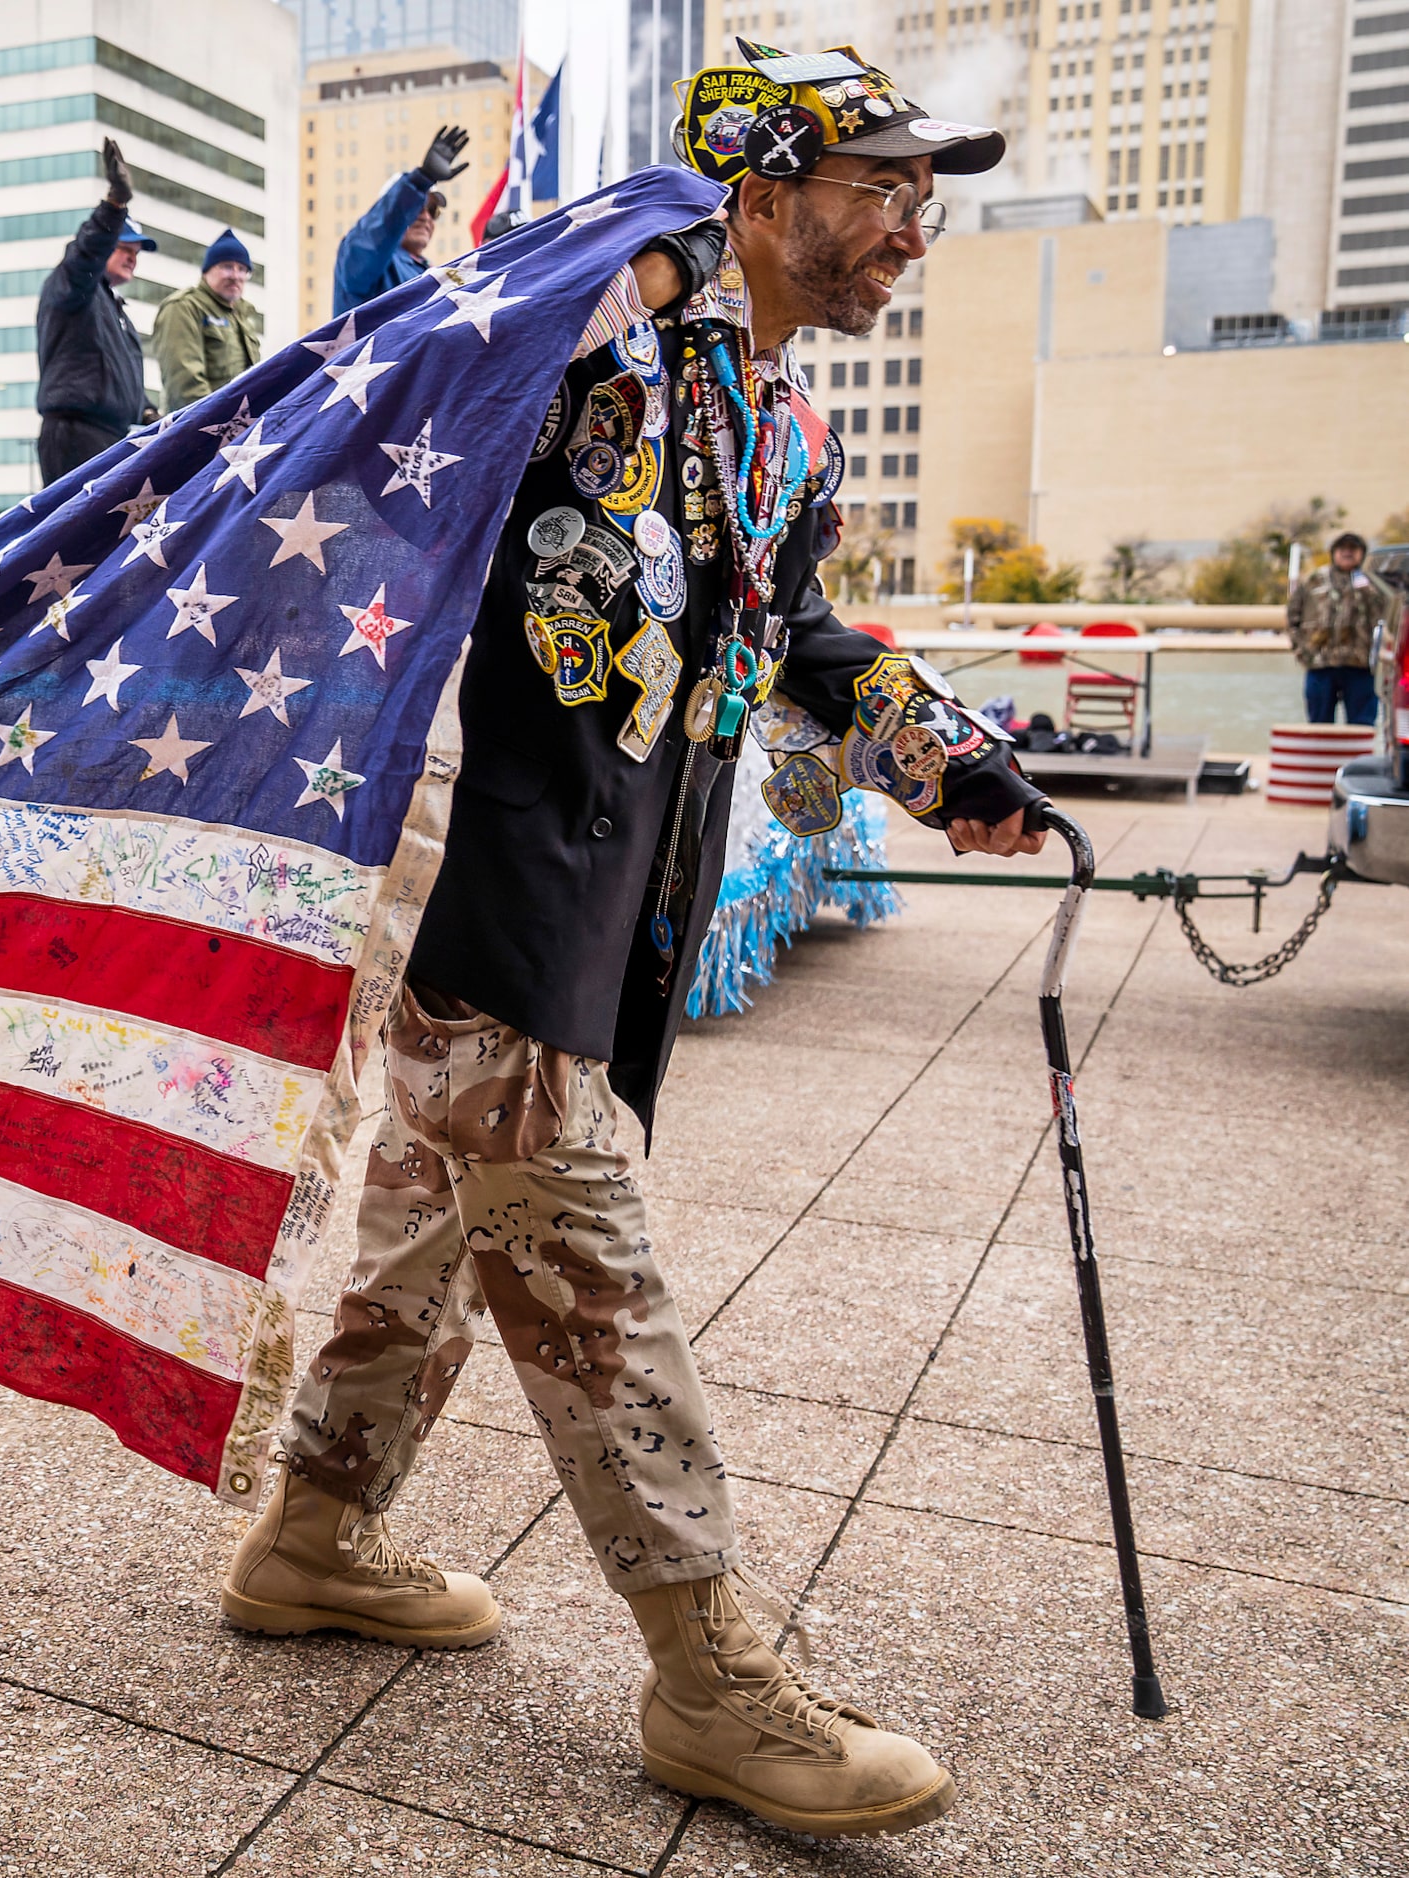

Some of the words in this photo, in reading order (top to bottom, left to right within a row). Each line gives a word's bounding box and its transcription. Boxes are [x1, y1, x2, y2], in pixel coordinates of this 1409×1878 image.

[698, 87, 755, 103] SHERIFF'S
[702, 74, 727, 88] SAN
[731, 74, 789, 99] FRANCISCO
[533, 390, 563, 455] RIFF
[829, 454, 842, 492] SERVICE
[605, 537, 630, 561] COUNTY
[644, 536, 659, 551] YOU
[556, 588, 579, 604] SBN
[547, 619, 592, 635] WARREN
[596, 638, 604, 683] RESCUE
